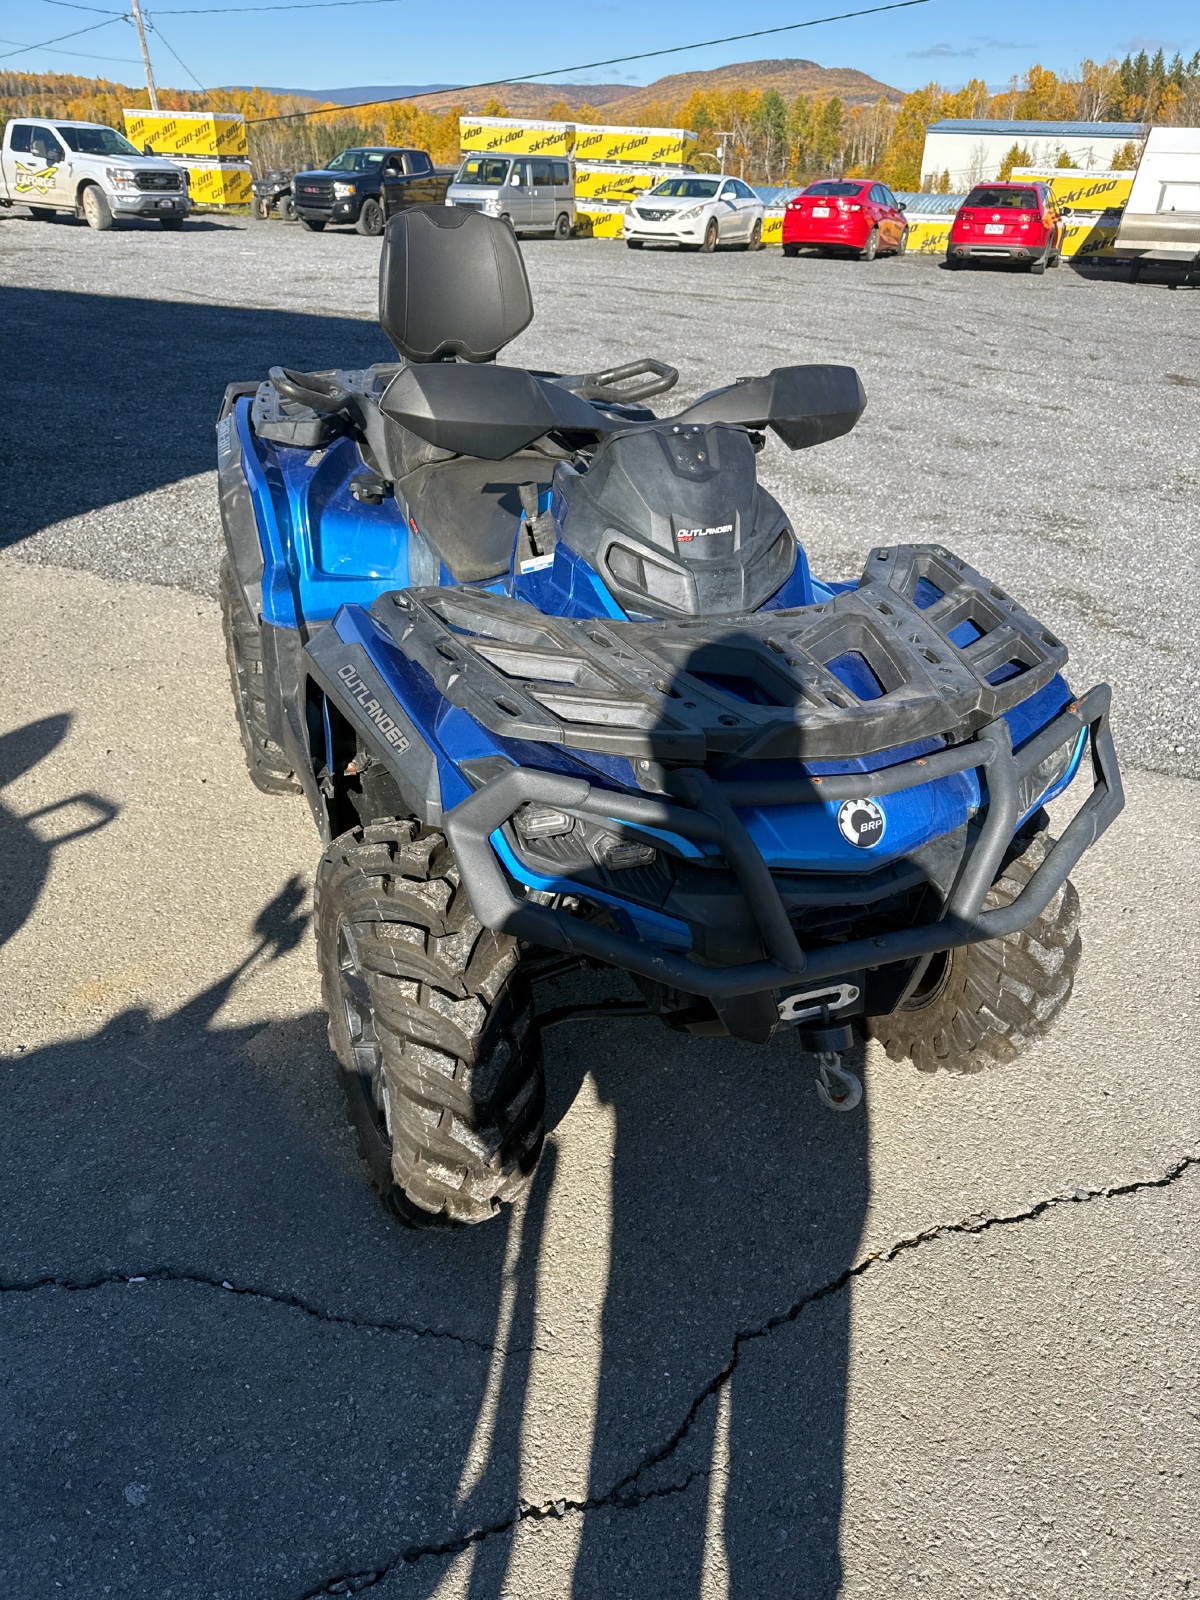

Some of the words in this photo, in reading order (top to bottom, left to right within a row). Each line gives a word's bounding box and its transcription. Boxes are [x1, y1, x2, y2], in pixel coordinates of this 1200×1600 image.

[175, 121, 210, 149] can-am
[486, 129, 524, 150] ski-doo
[528, 130, 570, 153] ski-doo
[606, 136, 648, 158] ski-doo
[17, 174, 55, 188] LAFORGE
[1056, 180, 1118, 207] ski-doo
[677, 524, 733, 537] OUTLANDER
[337, 664, 411, 754] OUTLANDER
[860, 819, 882, 832] BRP
